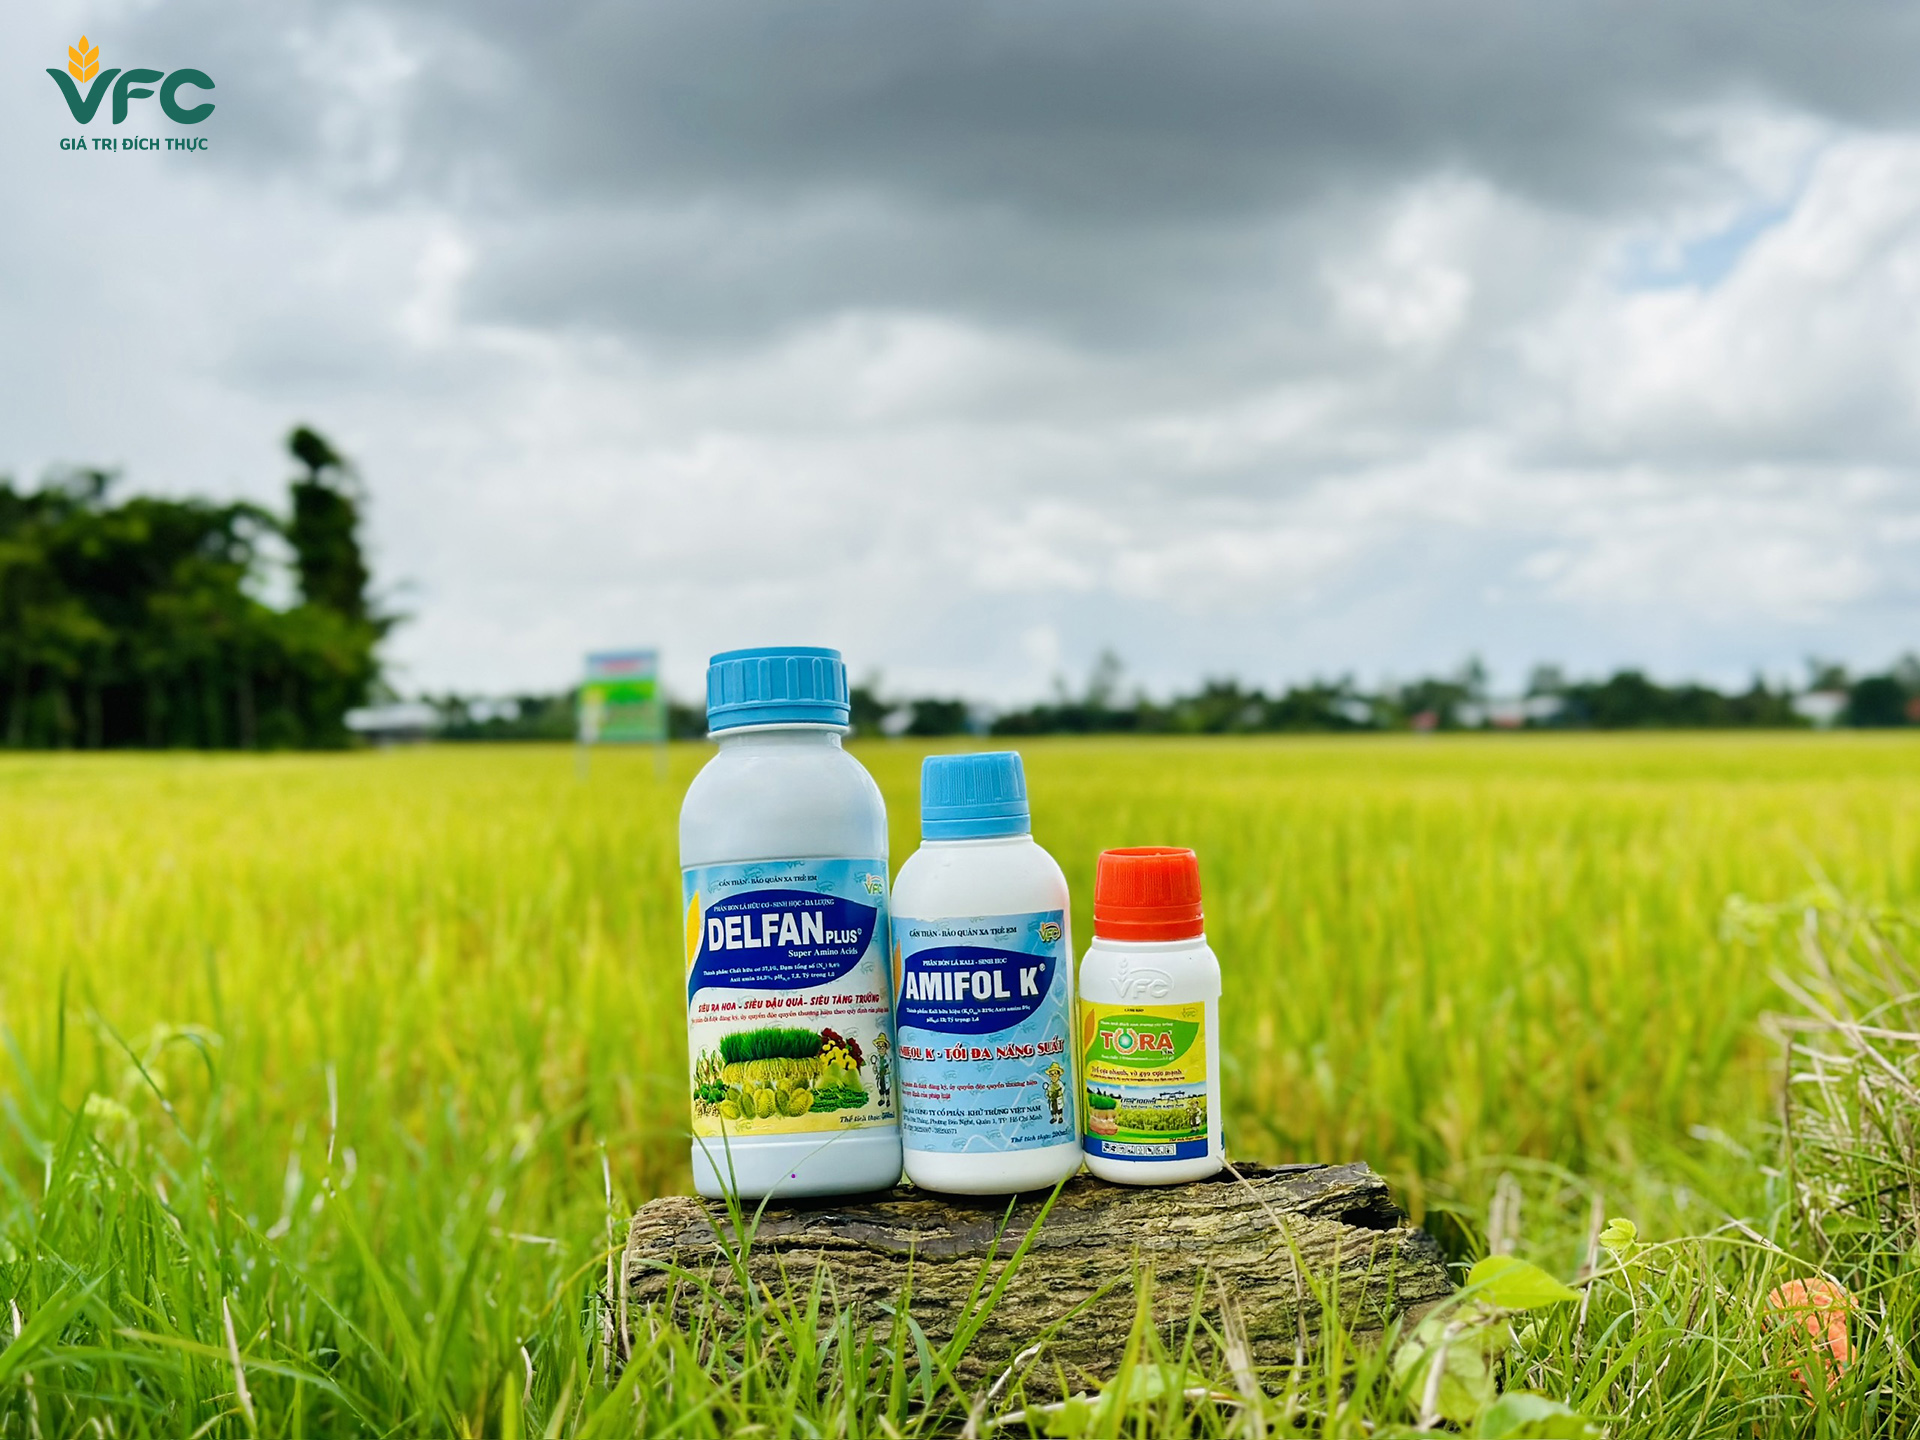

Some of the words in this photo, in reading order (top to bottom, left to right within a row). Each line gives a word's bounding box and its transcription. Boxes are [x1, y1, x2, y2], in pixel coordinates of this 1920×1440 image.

[707, 911, 824, 951] DELFAN
[979, 928, 989, 936] XA
[1006, 926, 1017, 934] EM
[788, 949, 812, 959] Super
[814, 949, 839, 957] Amino
[905, 969, 1011, 1001] AMIFOL
[721, 1002, 736, 1011] HOA
[744, 999, 763, 1010] SIÊU
[765, 997, 784, 1010] ĐẬU
[810, 995, 830, 1006] SIÊU
[926, 1049, 935, 1061] K
[944, 1040, 968, 1061] TỐI
[971, 1047, 993, 1061] ĐA
[996, 1044, 1034, 1060] NĂNG
[1100, 1028, 1174, 1055] TORA
[1026, 1105, 1041, 1113] NAM
